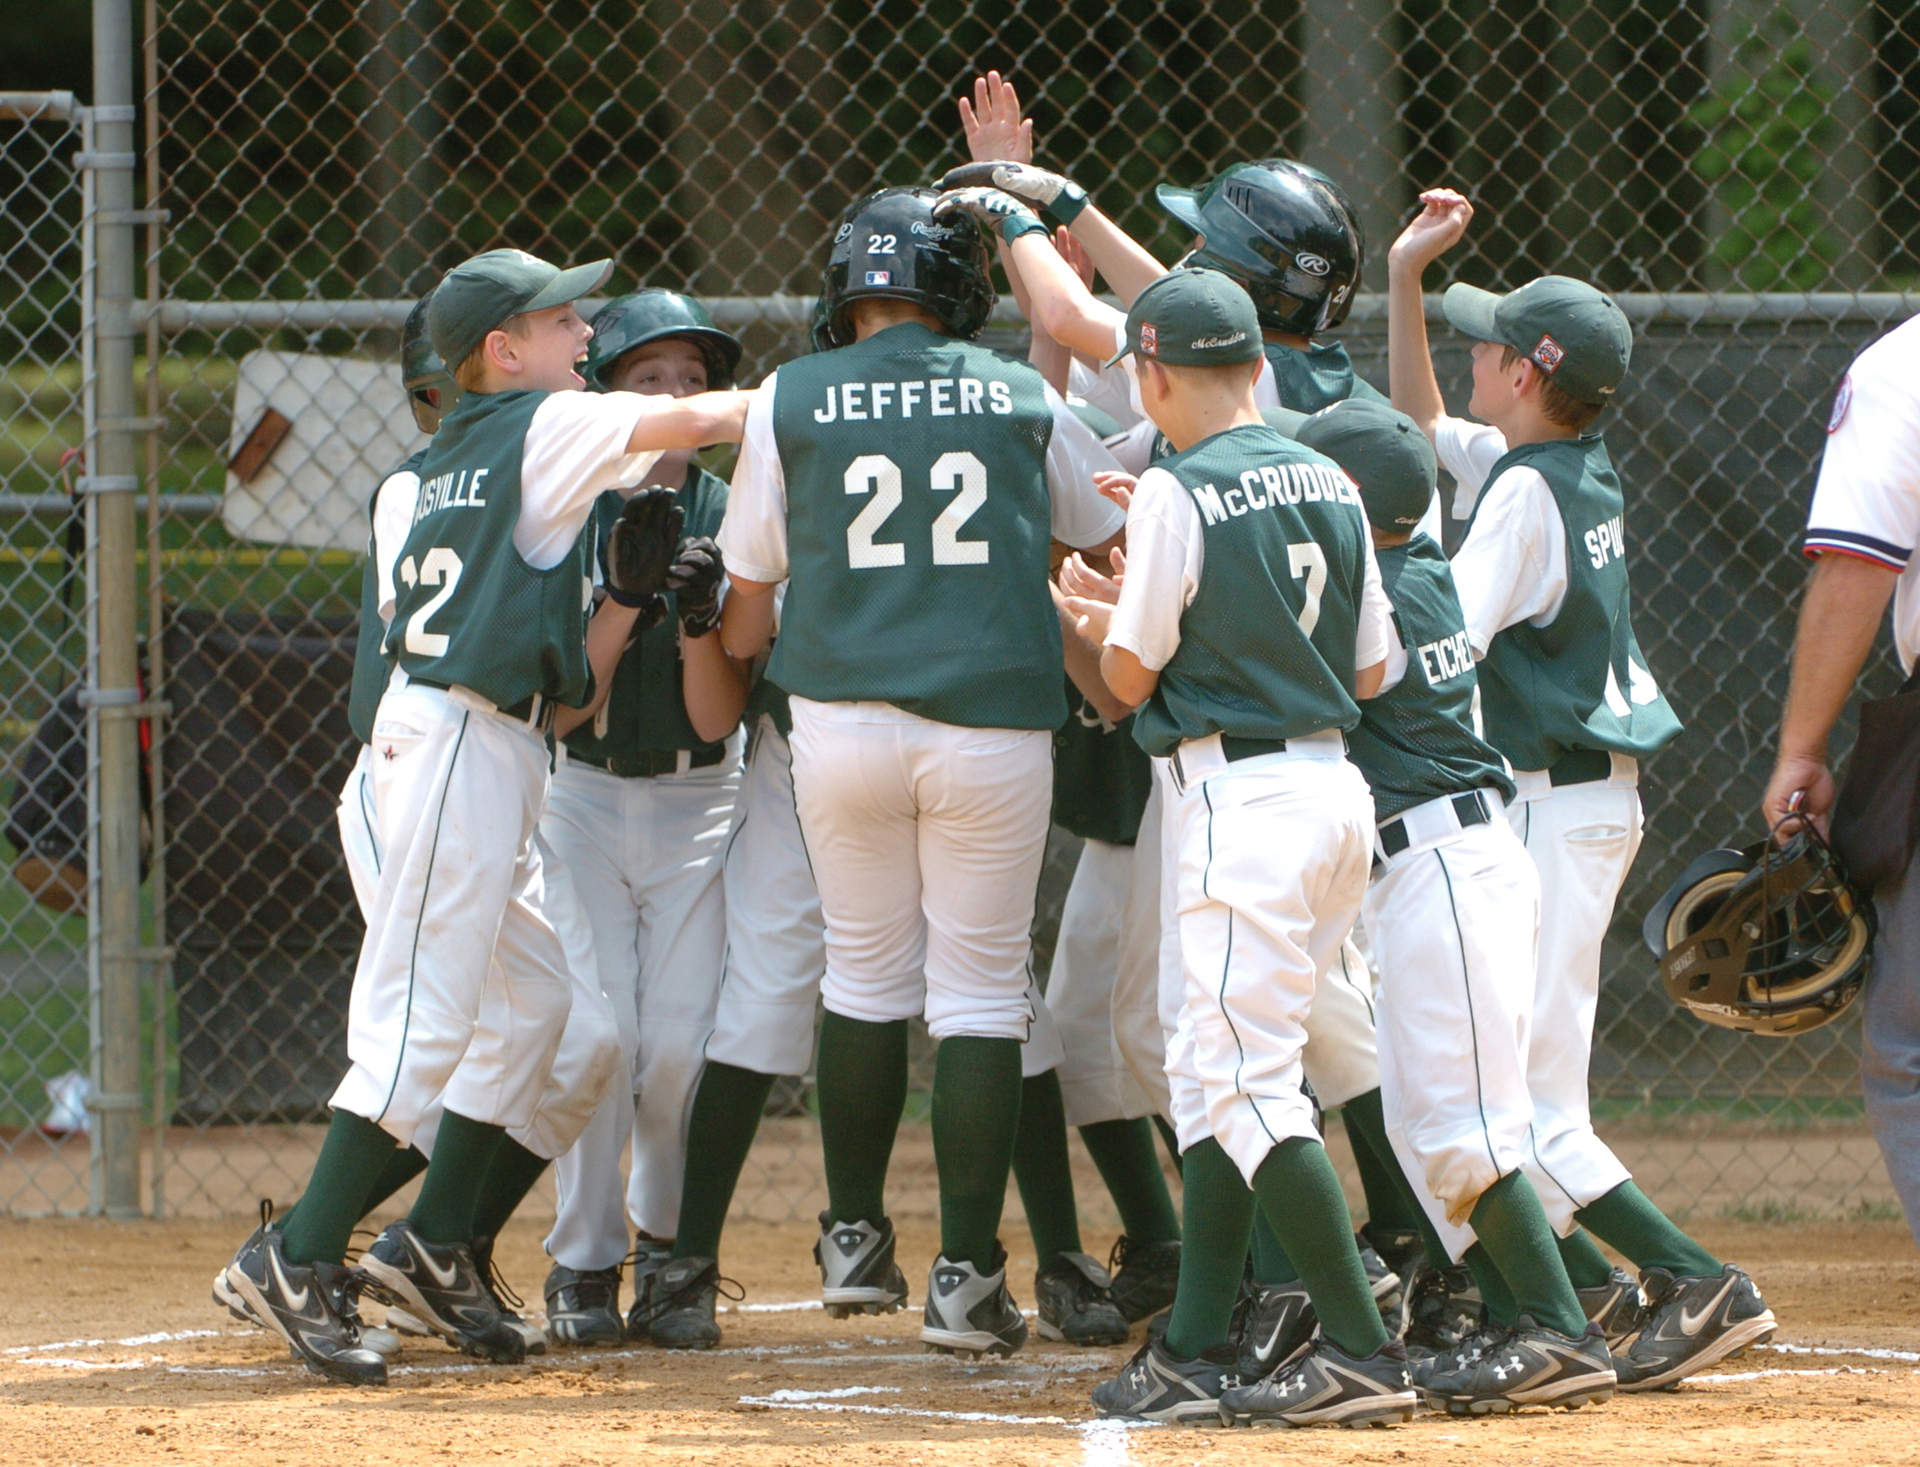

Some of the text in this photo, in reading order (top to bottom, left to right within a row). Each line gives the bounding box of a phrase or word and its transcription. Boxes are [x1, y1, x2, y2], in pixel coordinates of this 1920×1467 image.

[867, 234, 897, 255] 22
[814, 378, 1014, 424] JEFFERS
[414, 468, 490, 527] USVILLE
[844, 451, 990, 569] 22
[1287, 542, 1328, 640] 7
